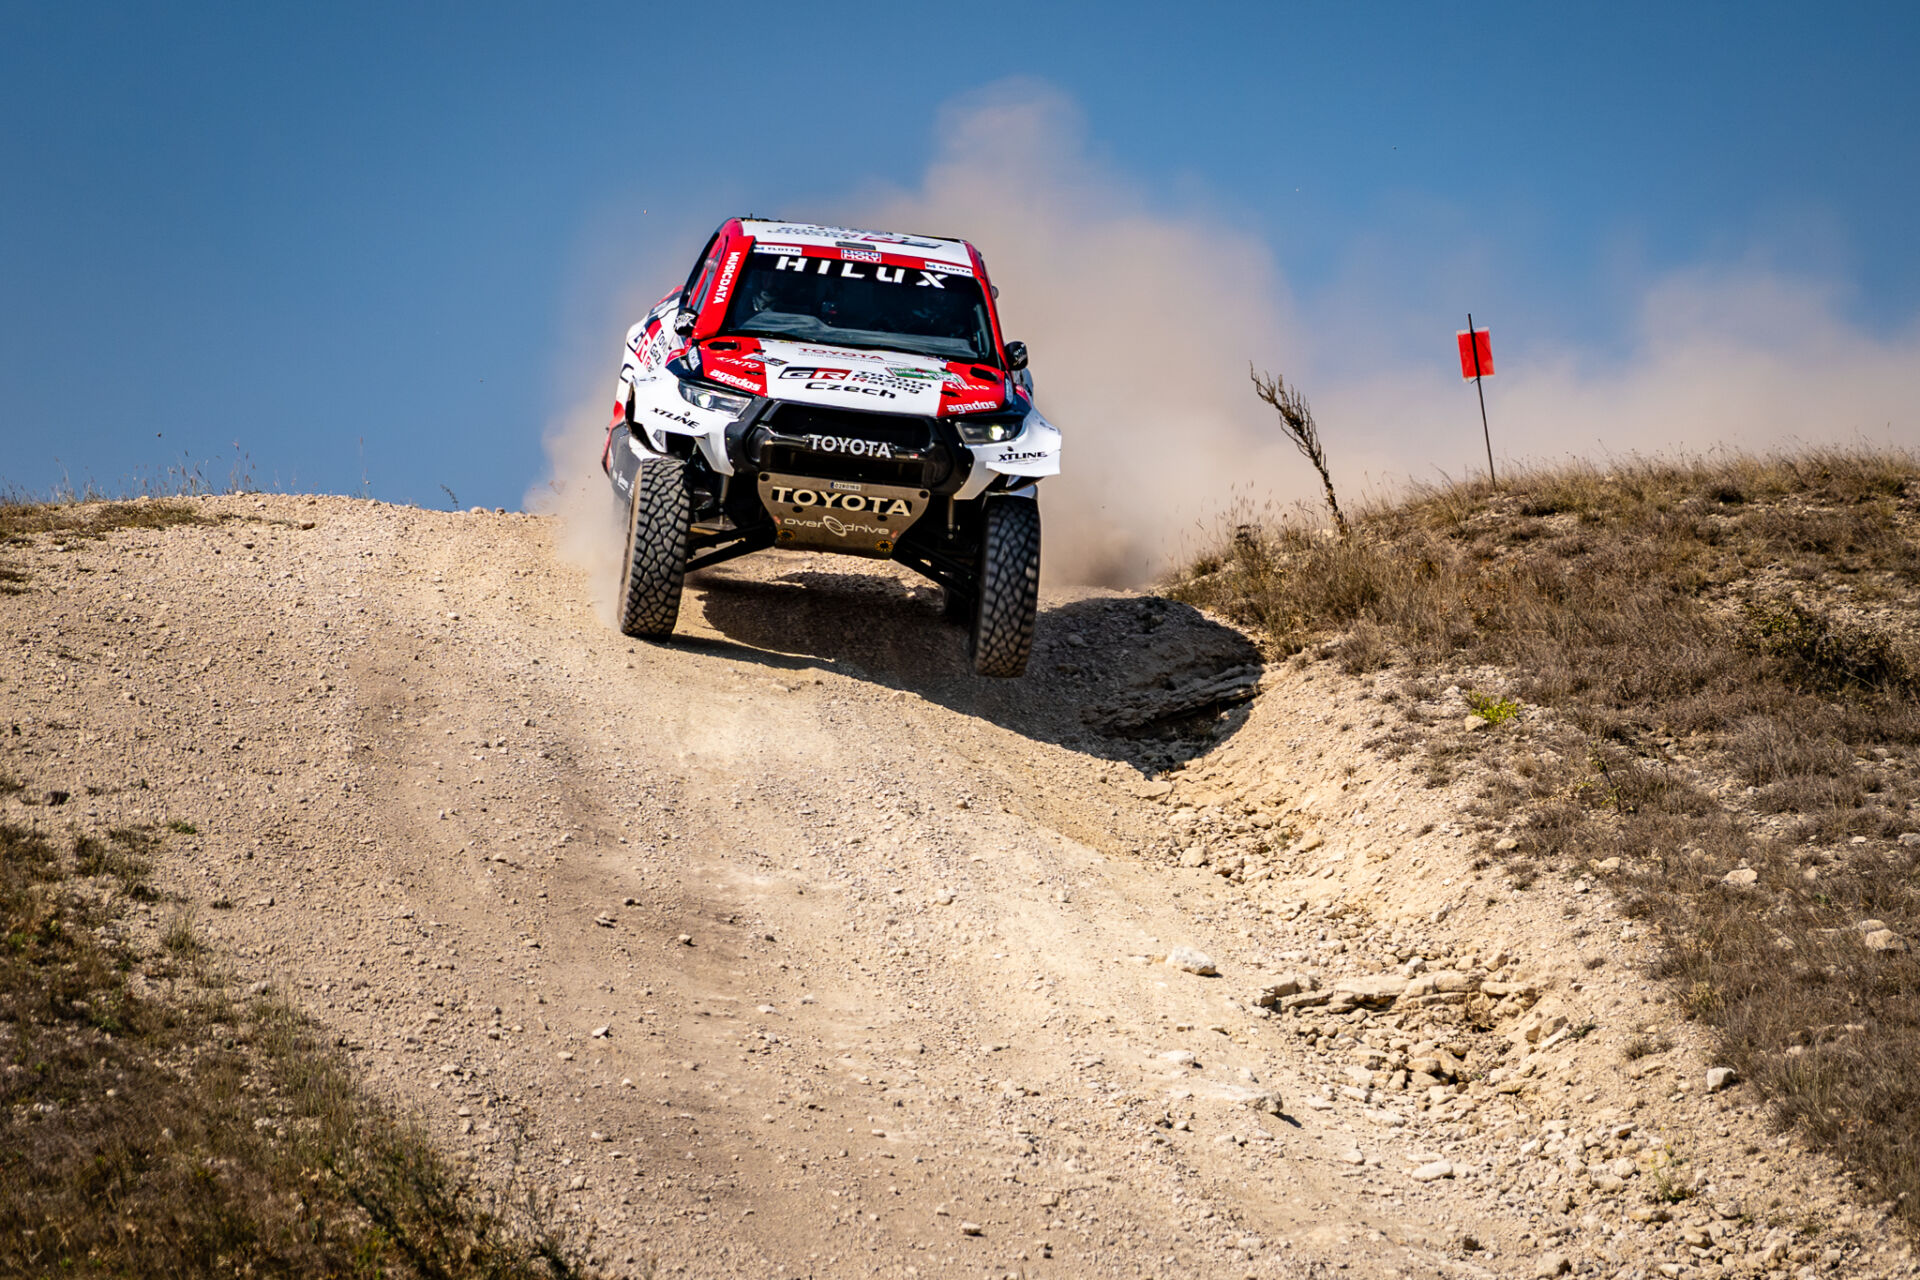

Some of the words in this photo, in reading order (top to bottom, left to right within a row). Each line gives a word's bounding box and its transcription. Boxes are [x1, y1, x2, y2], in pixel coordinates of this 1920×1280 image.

[842, 253, 880, 262] MOLY
[713, 252, 741, 304] MUSICDATA
[776, 256, 948, 289] HILUX
[798, 348, 885, 361] TOYOTA
[709, 369, 762, 392] agados
[779, 367, 850, 380] GR
[805, 382, 896, 399] Czech
[946, 400, 998, 414] agados
[809, 434, 892, 458] TOYOTA
[998, 451, 1048, 462] XTLINE
[772, 486, 911, 517] TOYOTA
